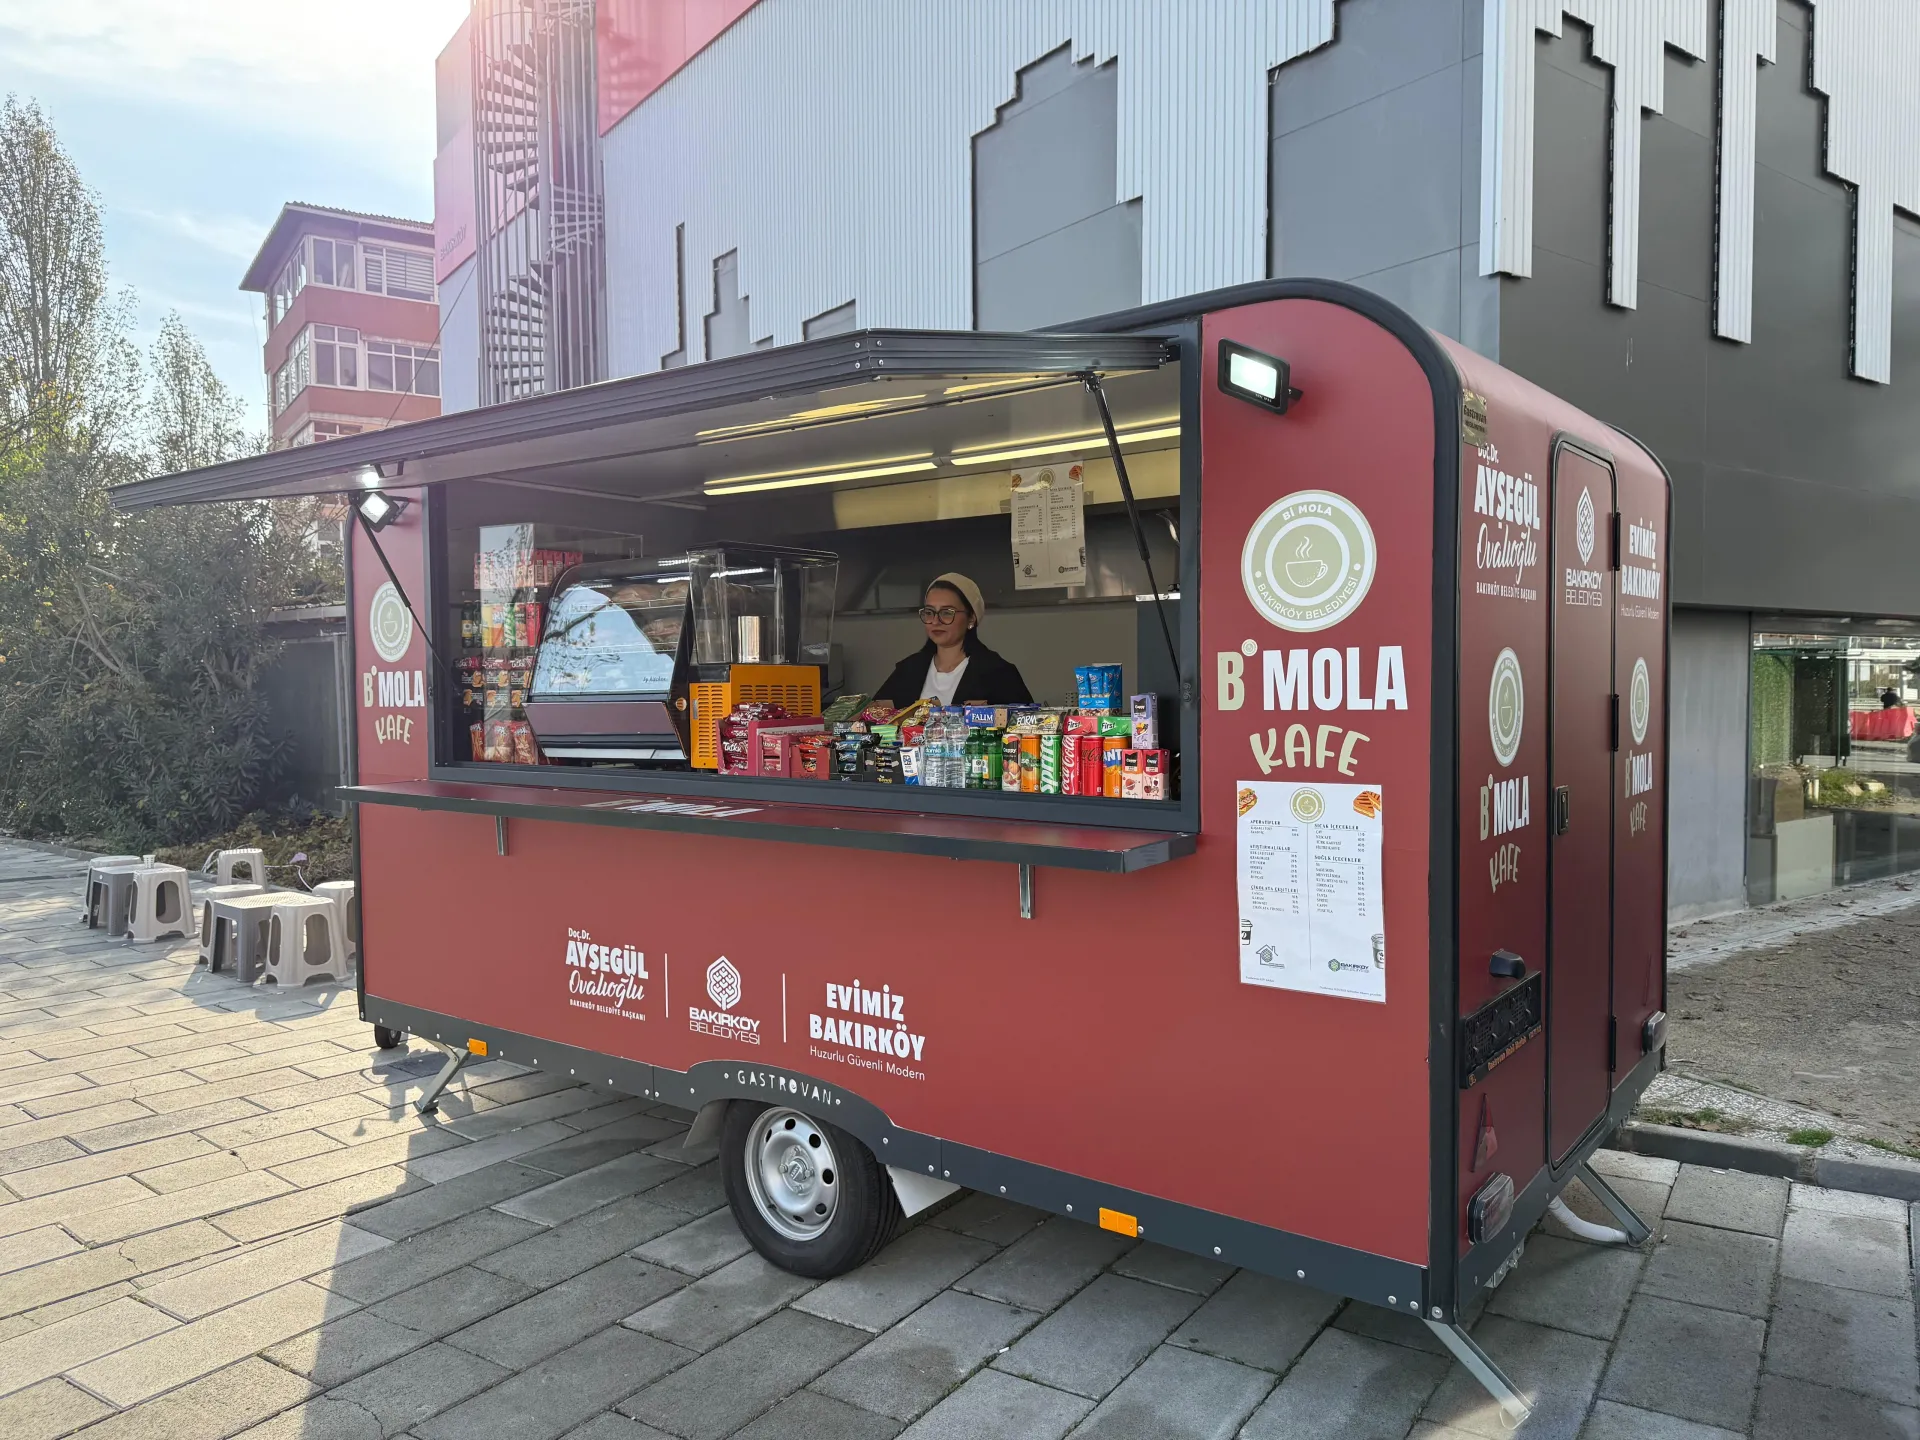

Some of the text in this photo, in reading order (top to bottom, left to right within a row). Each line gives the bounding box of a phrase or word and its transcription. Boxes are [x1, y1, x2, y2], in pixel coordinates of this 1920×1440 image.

[1298, 504, 1332, 516] MOLA
[1474, 464, 1540, 530] AYŞEGÜL
[1476, 523, 1537, 585] Ovalıoğlu
[1629, 517, 1656, 559] EVİMİZ
[1621, 562, 1660, 600] BAKIRKÖY
[1257, 583, 1303, 619] BAKIRKÖY
[378, 670, 425, 707] MOLA
[1263, 645, 1409, 711] MOLA
[375, 714, 414, 745] KAFE
[971, 713, 993, 721] FALIM
[1101, 721, 1116, 729] First
[1249, 723, 1371, 777] KAFE
[1632, 752, 1653, 796] MOLA
[1493, 775, 1530, 836] MOLA
[1630, 801, 1648, 837] KAFE
[1489, 843, 1521, 893] KAFE
[568, 927, 591, 941] Doç.Dr.
[565, 940, 649, 980] AYŞEGÜL
[569, 969, 645, 1008] Ovalıoğlu
[826, 978, 905, 1022] EVİMİZ
[569, 998, 646, 1022] BAKIRKÖY BELEDİYE BAŞKANI
[689, 1006, 760, 1033] BAKIRKÖY
[809, 1013, 926, 1062] BAKIRKÖY
[810, 1045, 925, 1081] Huzurlu Güvenli Modern
[737, 1070, 832, 1105] GASTROVAN
